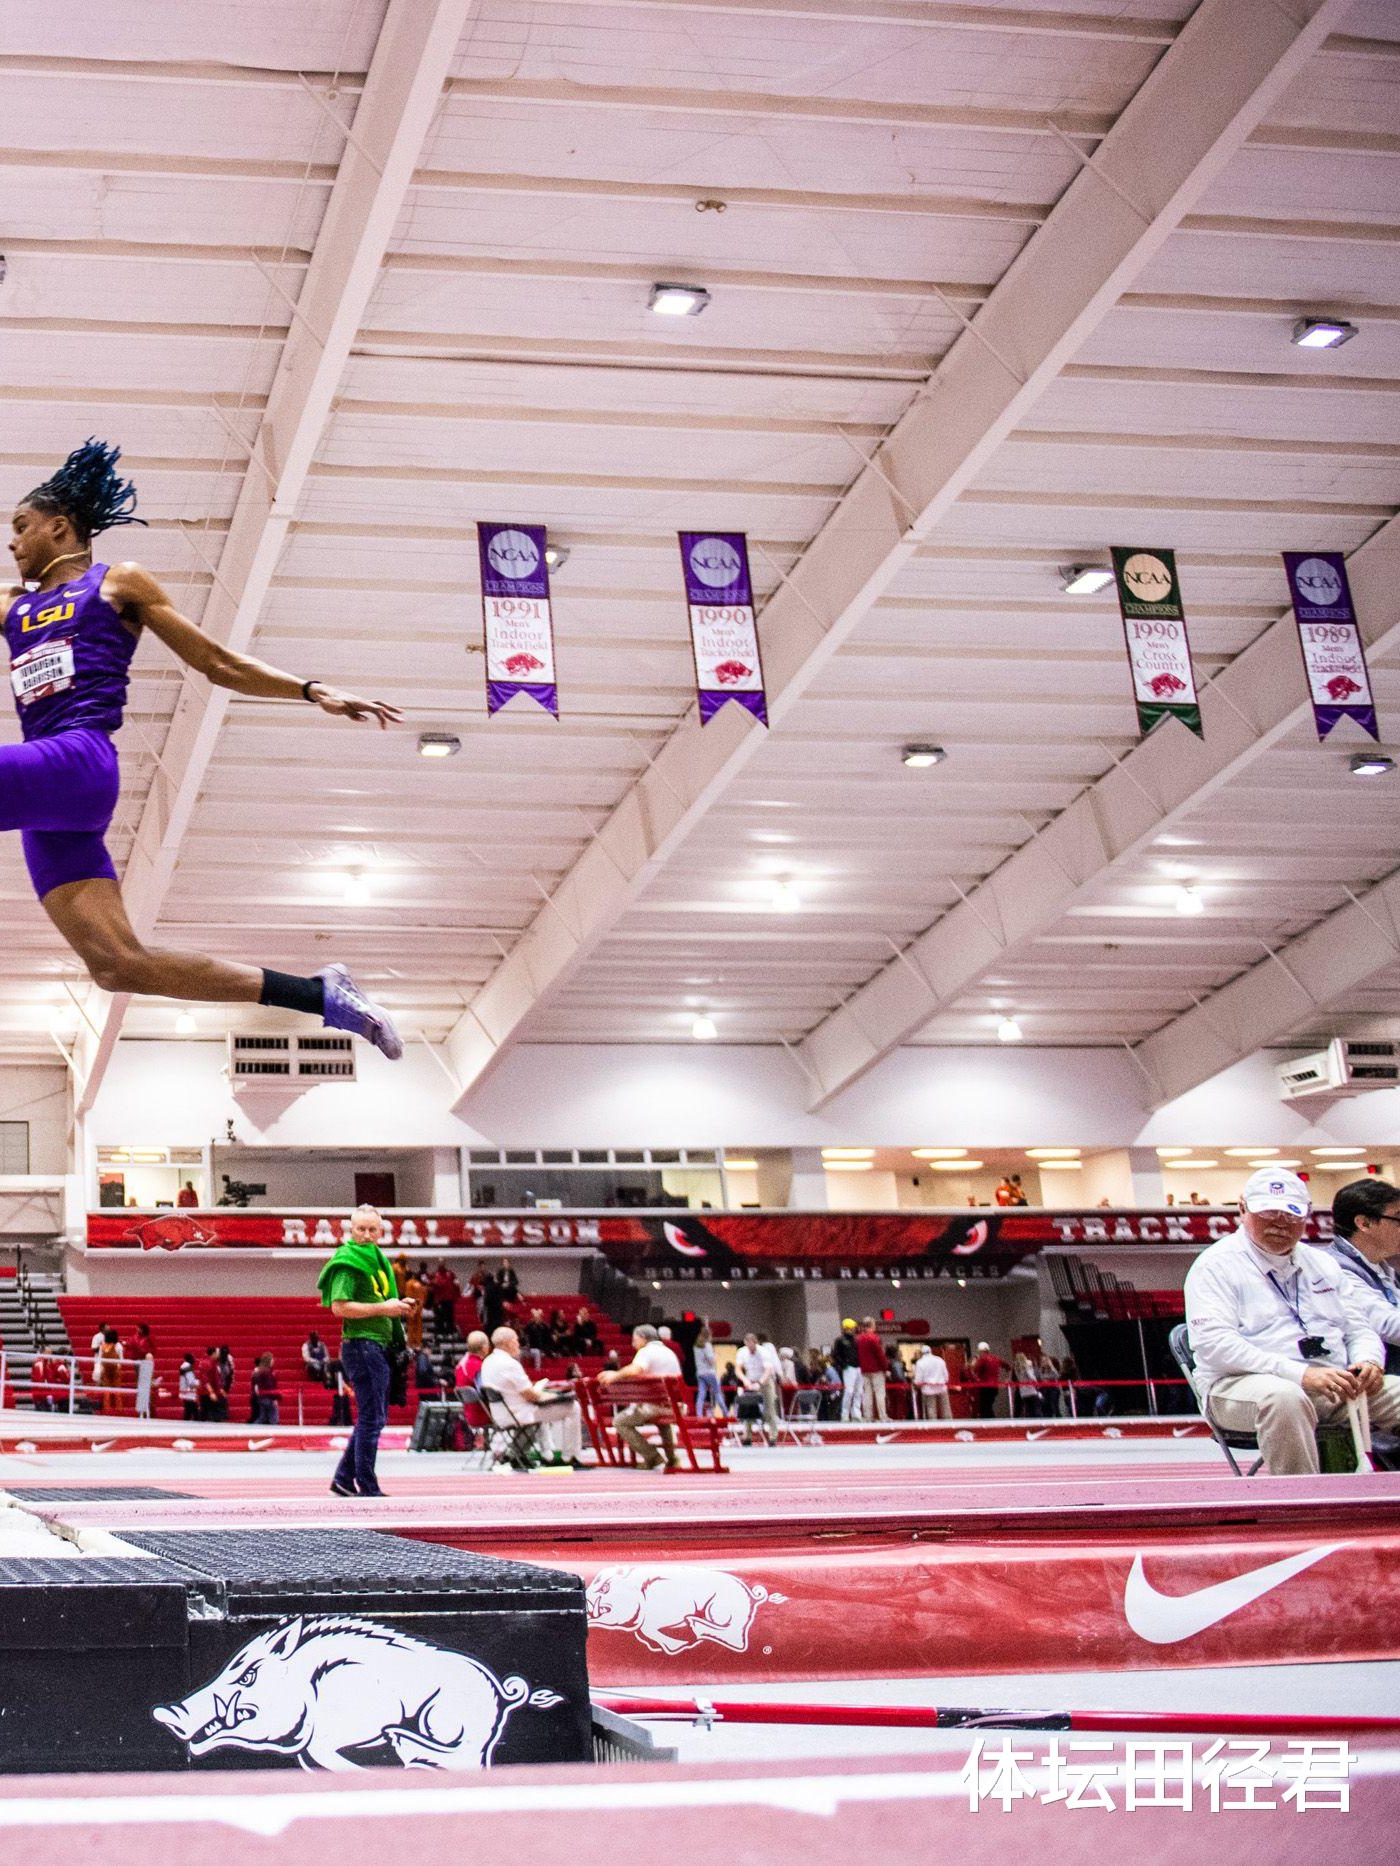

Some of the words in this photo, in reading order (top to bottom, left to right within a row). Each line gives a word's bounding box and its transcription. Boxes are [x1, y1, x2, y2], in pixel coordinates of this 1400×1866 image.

[491, 548, 538, 561] NCAA
[692, 557, 741, 569] NCAA
[1125, 571, 1172, 584] NCAA
[1297, 576, 1342, 588] NCAA
[493, 600, 541, 619] 1991
[21, 602, 76, 633] LSU
[697, 608, 746, 625] 1990
[494, 628, 544, 639] Indoor
[1133, 622, 1179, 640] 1990
[1308, 626, 1351, 643] 1989
[702, 637, 749, 647] Indoor
[1143, 649, 1177, 661] Cross
[1313, 653, 1357, 664] Indoor
[1137, 660, 1186, 673] Country
[463, 1218, 602, 1245] TYSON
[1052, 1216, 1195, 1242] TRACK
[644, 1266, 714, 1280] HOME
[730, 1266, 761, 1280] OF
[776, 1266, 823, 1279] THE
